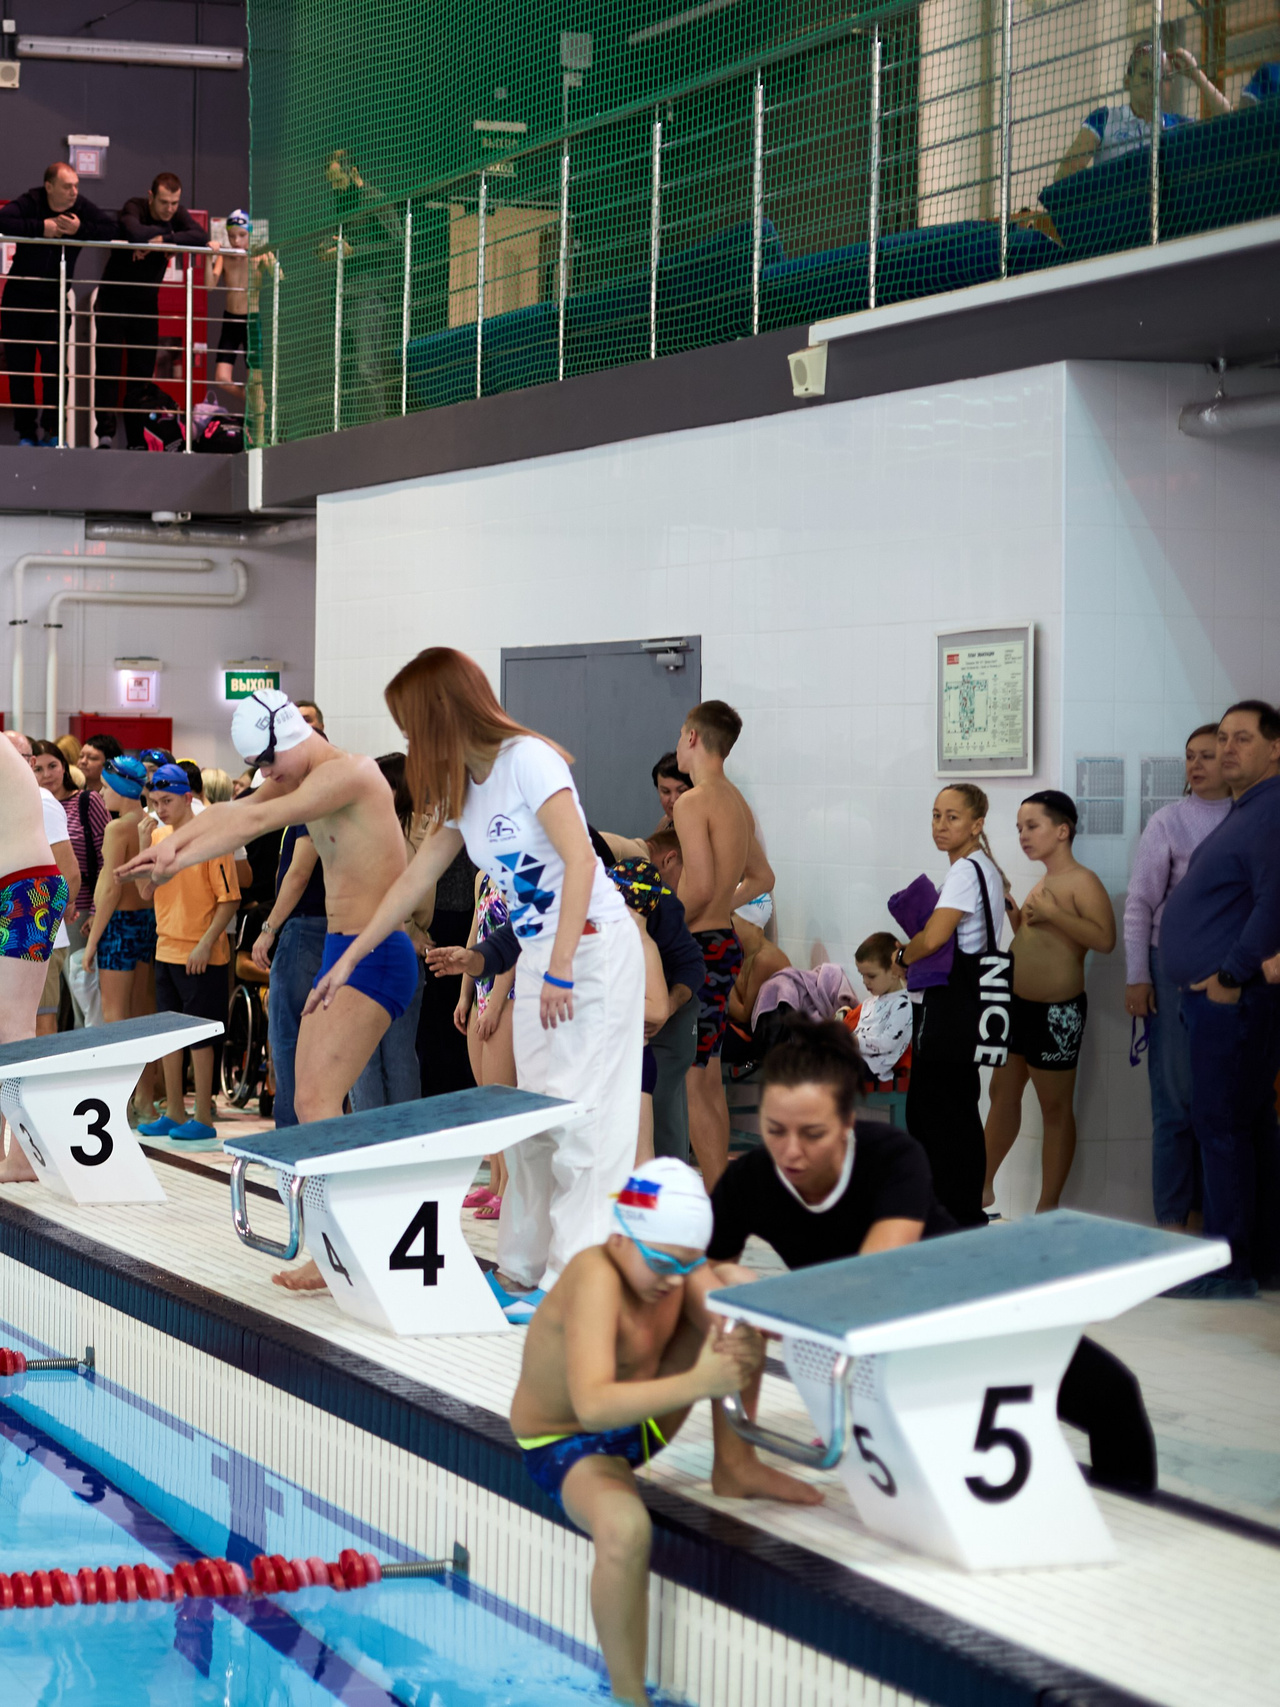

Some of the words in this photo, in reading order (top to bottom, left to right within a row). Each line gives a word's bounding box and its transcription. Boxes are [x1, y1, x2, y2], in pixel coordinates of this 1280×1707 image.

[231, 678, 274, 692] ВЫХОД
[973, 956, 1011, 1066] NICE
[1041, 1050, 1077, 1062] WOLF
[70, 1098, 114, 1167] 3
[321, 1231, 353, 1287] 4
[389, 1201, 445, 1286] 4
[853, 1424, 898, 1498] 5
[965, 1384, 1033, 1504] 5
